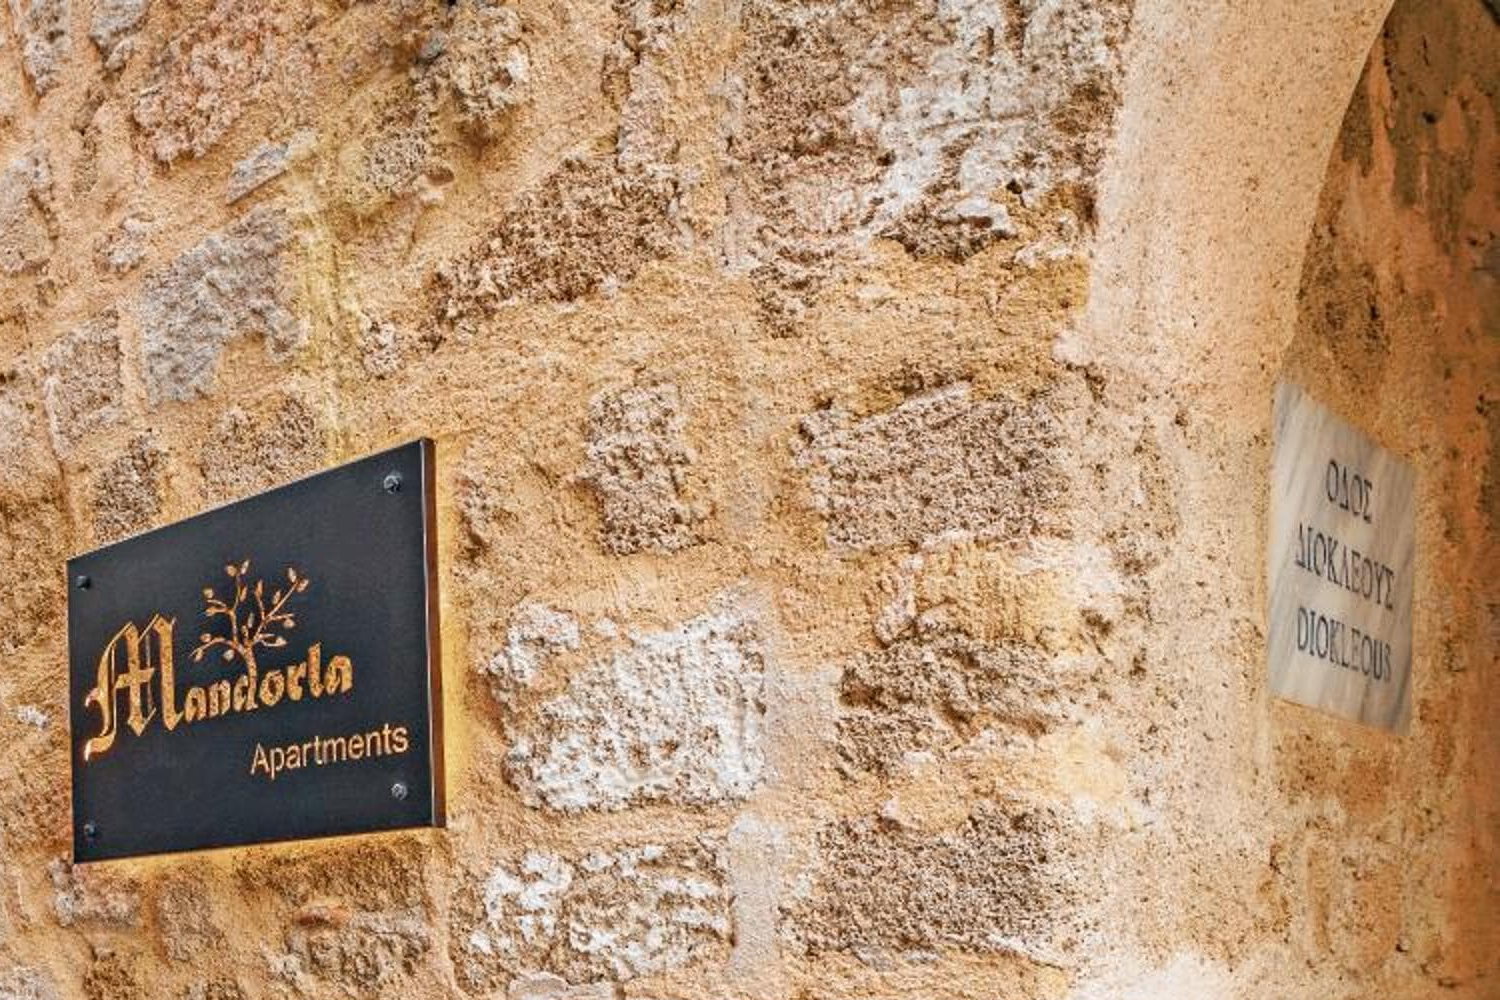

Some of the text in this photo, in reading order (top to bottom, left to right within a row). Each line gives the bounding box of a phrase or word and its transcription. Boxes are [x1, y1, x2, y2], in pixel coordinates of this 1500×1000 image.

[1325, 458, 1373, 525] ΟΔΟΣ
[1295, 522, 1395, 612] ΔΙΟΚΛΕΟΥΣ
[1296, 606, 1392, 683] DIOKLEOUS
[84, 613, 354, 761] Mandorla
[249, 722, 410, 781] Apartments
